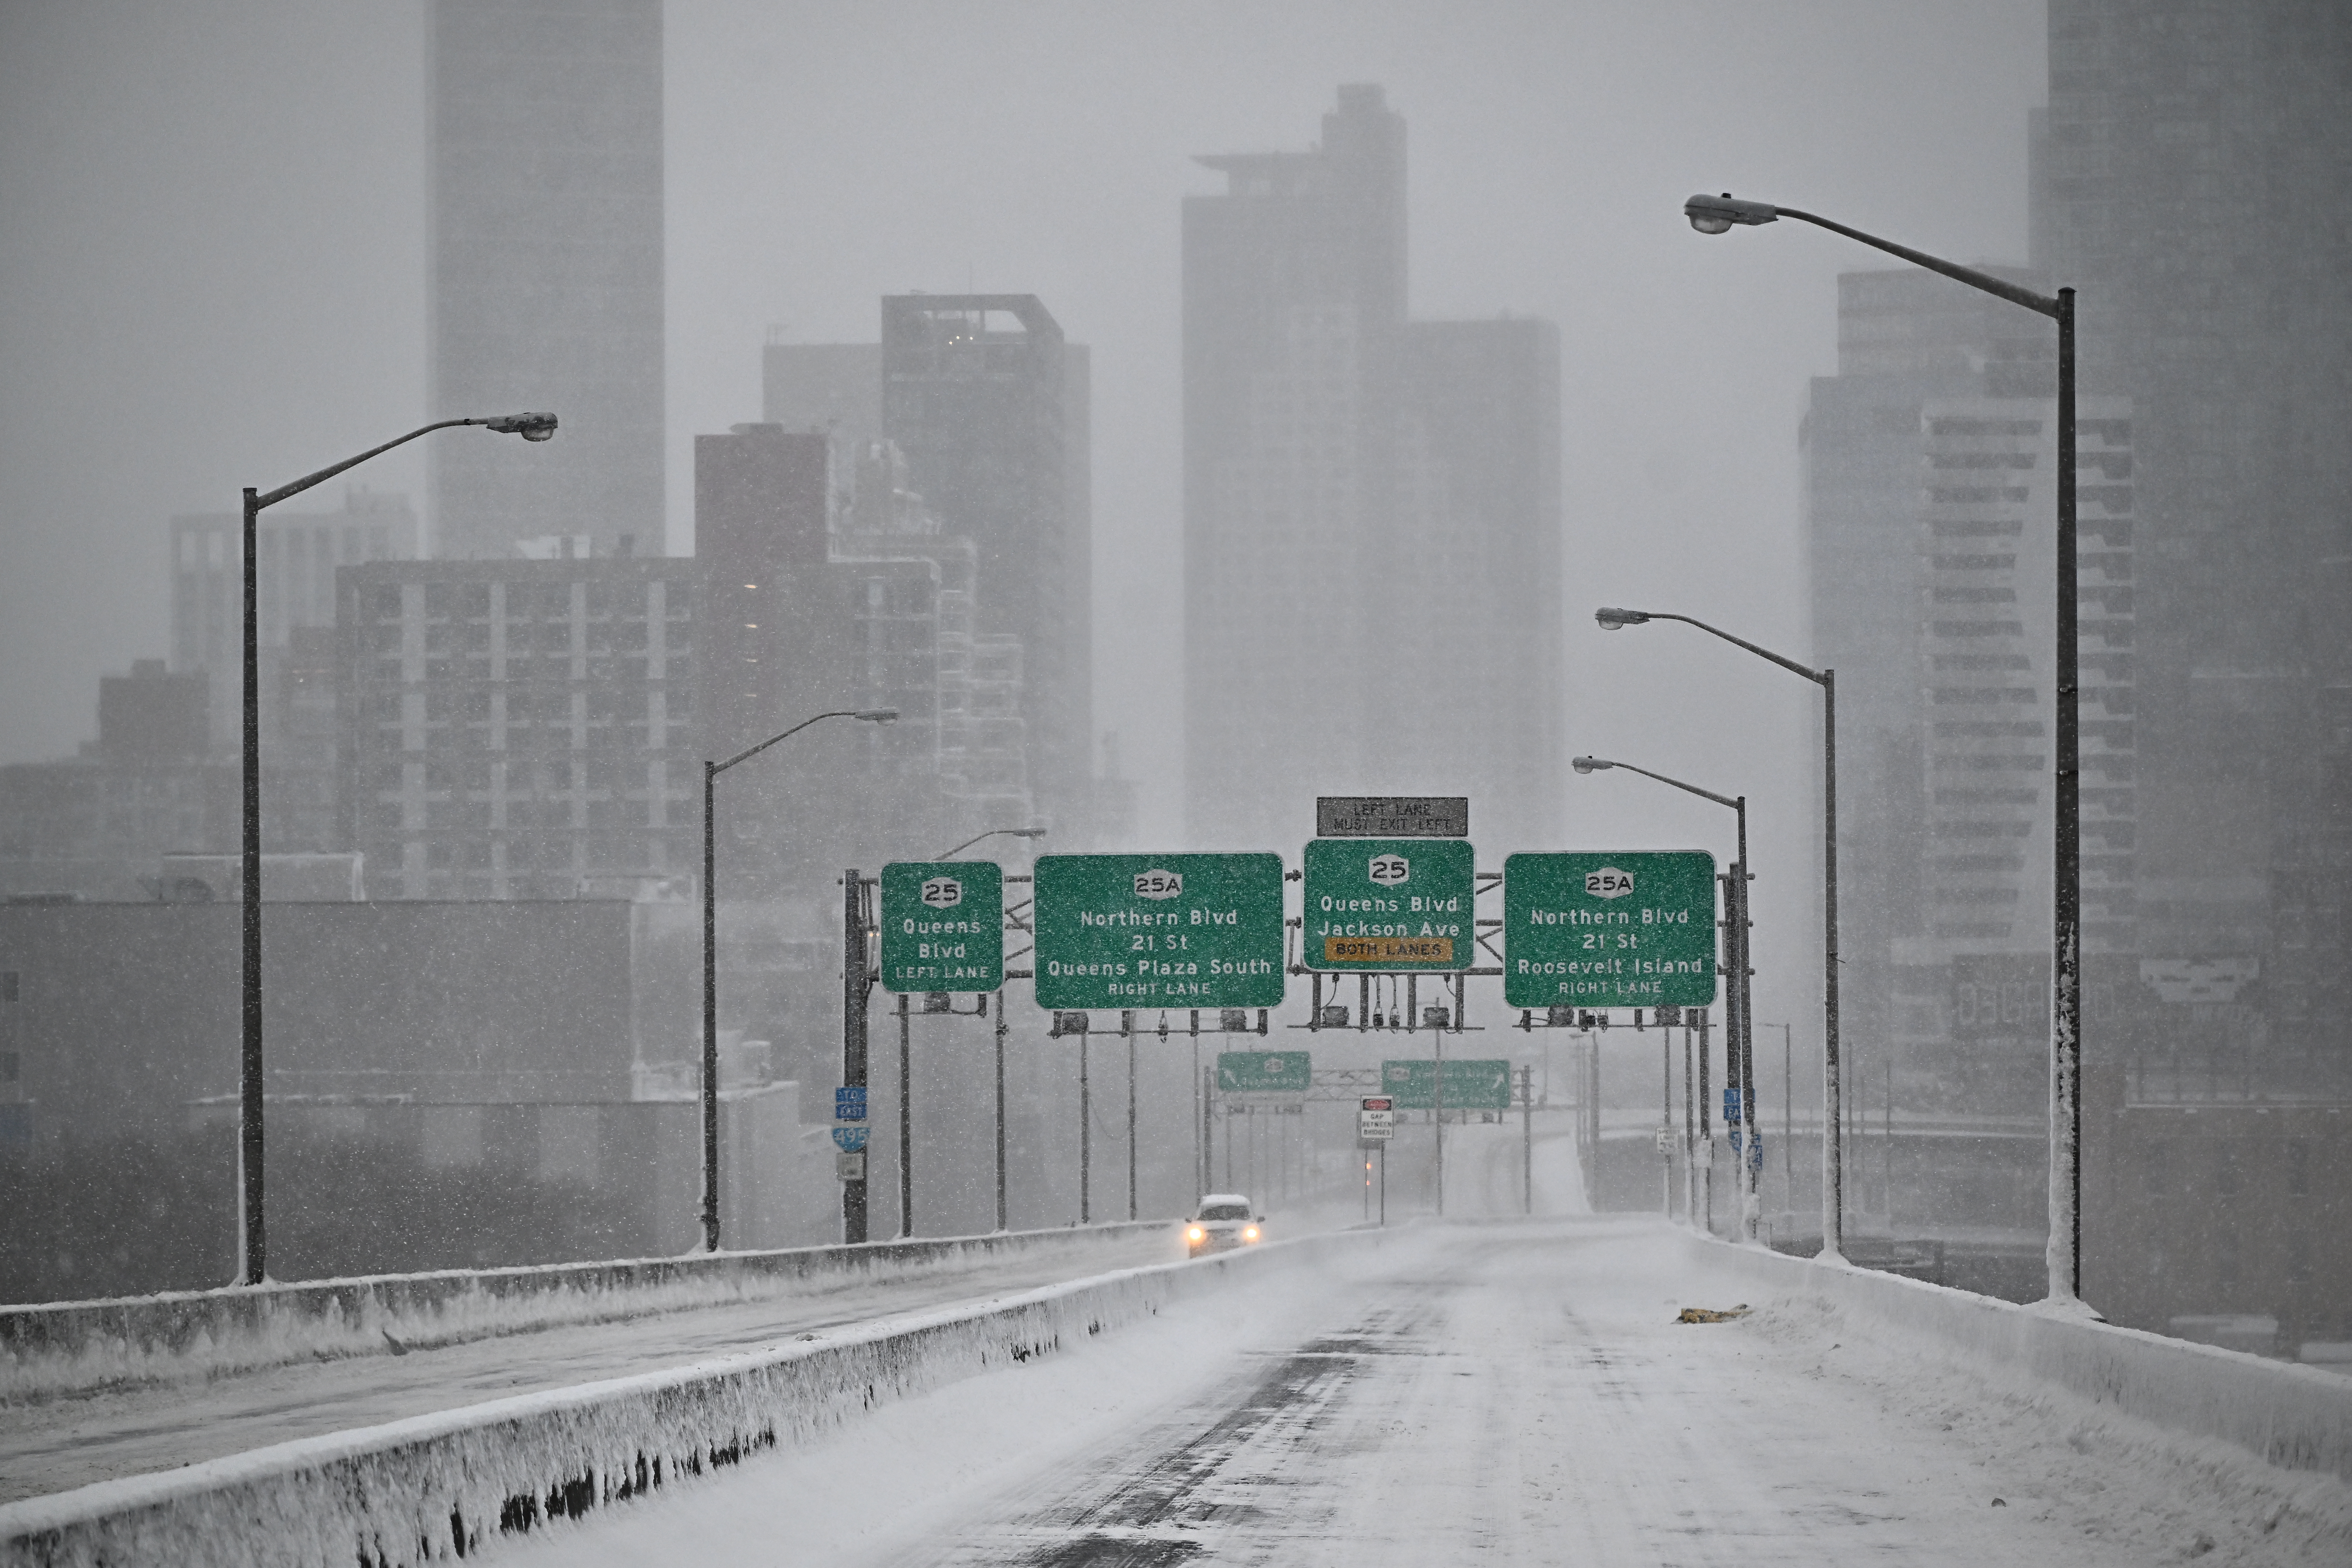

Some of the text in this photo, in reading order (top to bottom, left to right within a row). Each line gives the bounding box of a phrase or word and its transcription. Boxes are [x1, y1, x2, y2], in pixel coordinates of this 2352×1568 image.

[1354, 803, 1430, 816] LEFT LANE
[1334, 818, 1451, 830] MUST EXIT LEFT
[1372, 861, 1406, 879] 25
[1136, 877, 1180, 892] 25A
[1587, 876, 1631, 891] 25A
[925, 884, 958, 901] 25
[1321, 896, 1457, 912] Queens Blvd
[1081, 910, 1237, 926] Northern Blvd
[1531, 909, 1688, 925] Northern Blvd
[903, 919, 981, 934] Queens
[1318, 922, 1459, 936] Jackson Ave
[1132, 935, 1187, 950] 21 St
[1583, 934, 1637, 948] 21 St
[919, 944, 965, 958] Blvd
[1336, 943, 1441, 955] BOTH LANES
[896, 967, 988, 978] LEFT LANE
[1048, 959, 1271, 976] Queens Plaza South
[1519, 958, 1701, 974] Roosevelt Island
[1108, 983, 1210, 994] RIGHT LANE
[1559, 981, 1661, 993] RIGHT LANE
[844, 1091, 858, 1100] TO
[840, 1107, 862, 1116] EAST
[836, 1129, 868, 1144] 495
